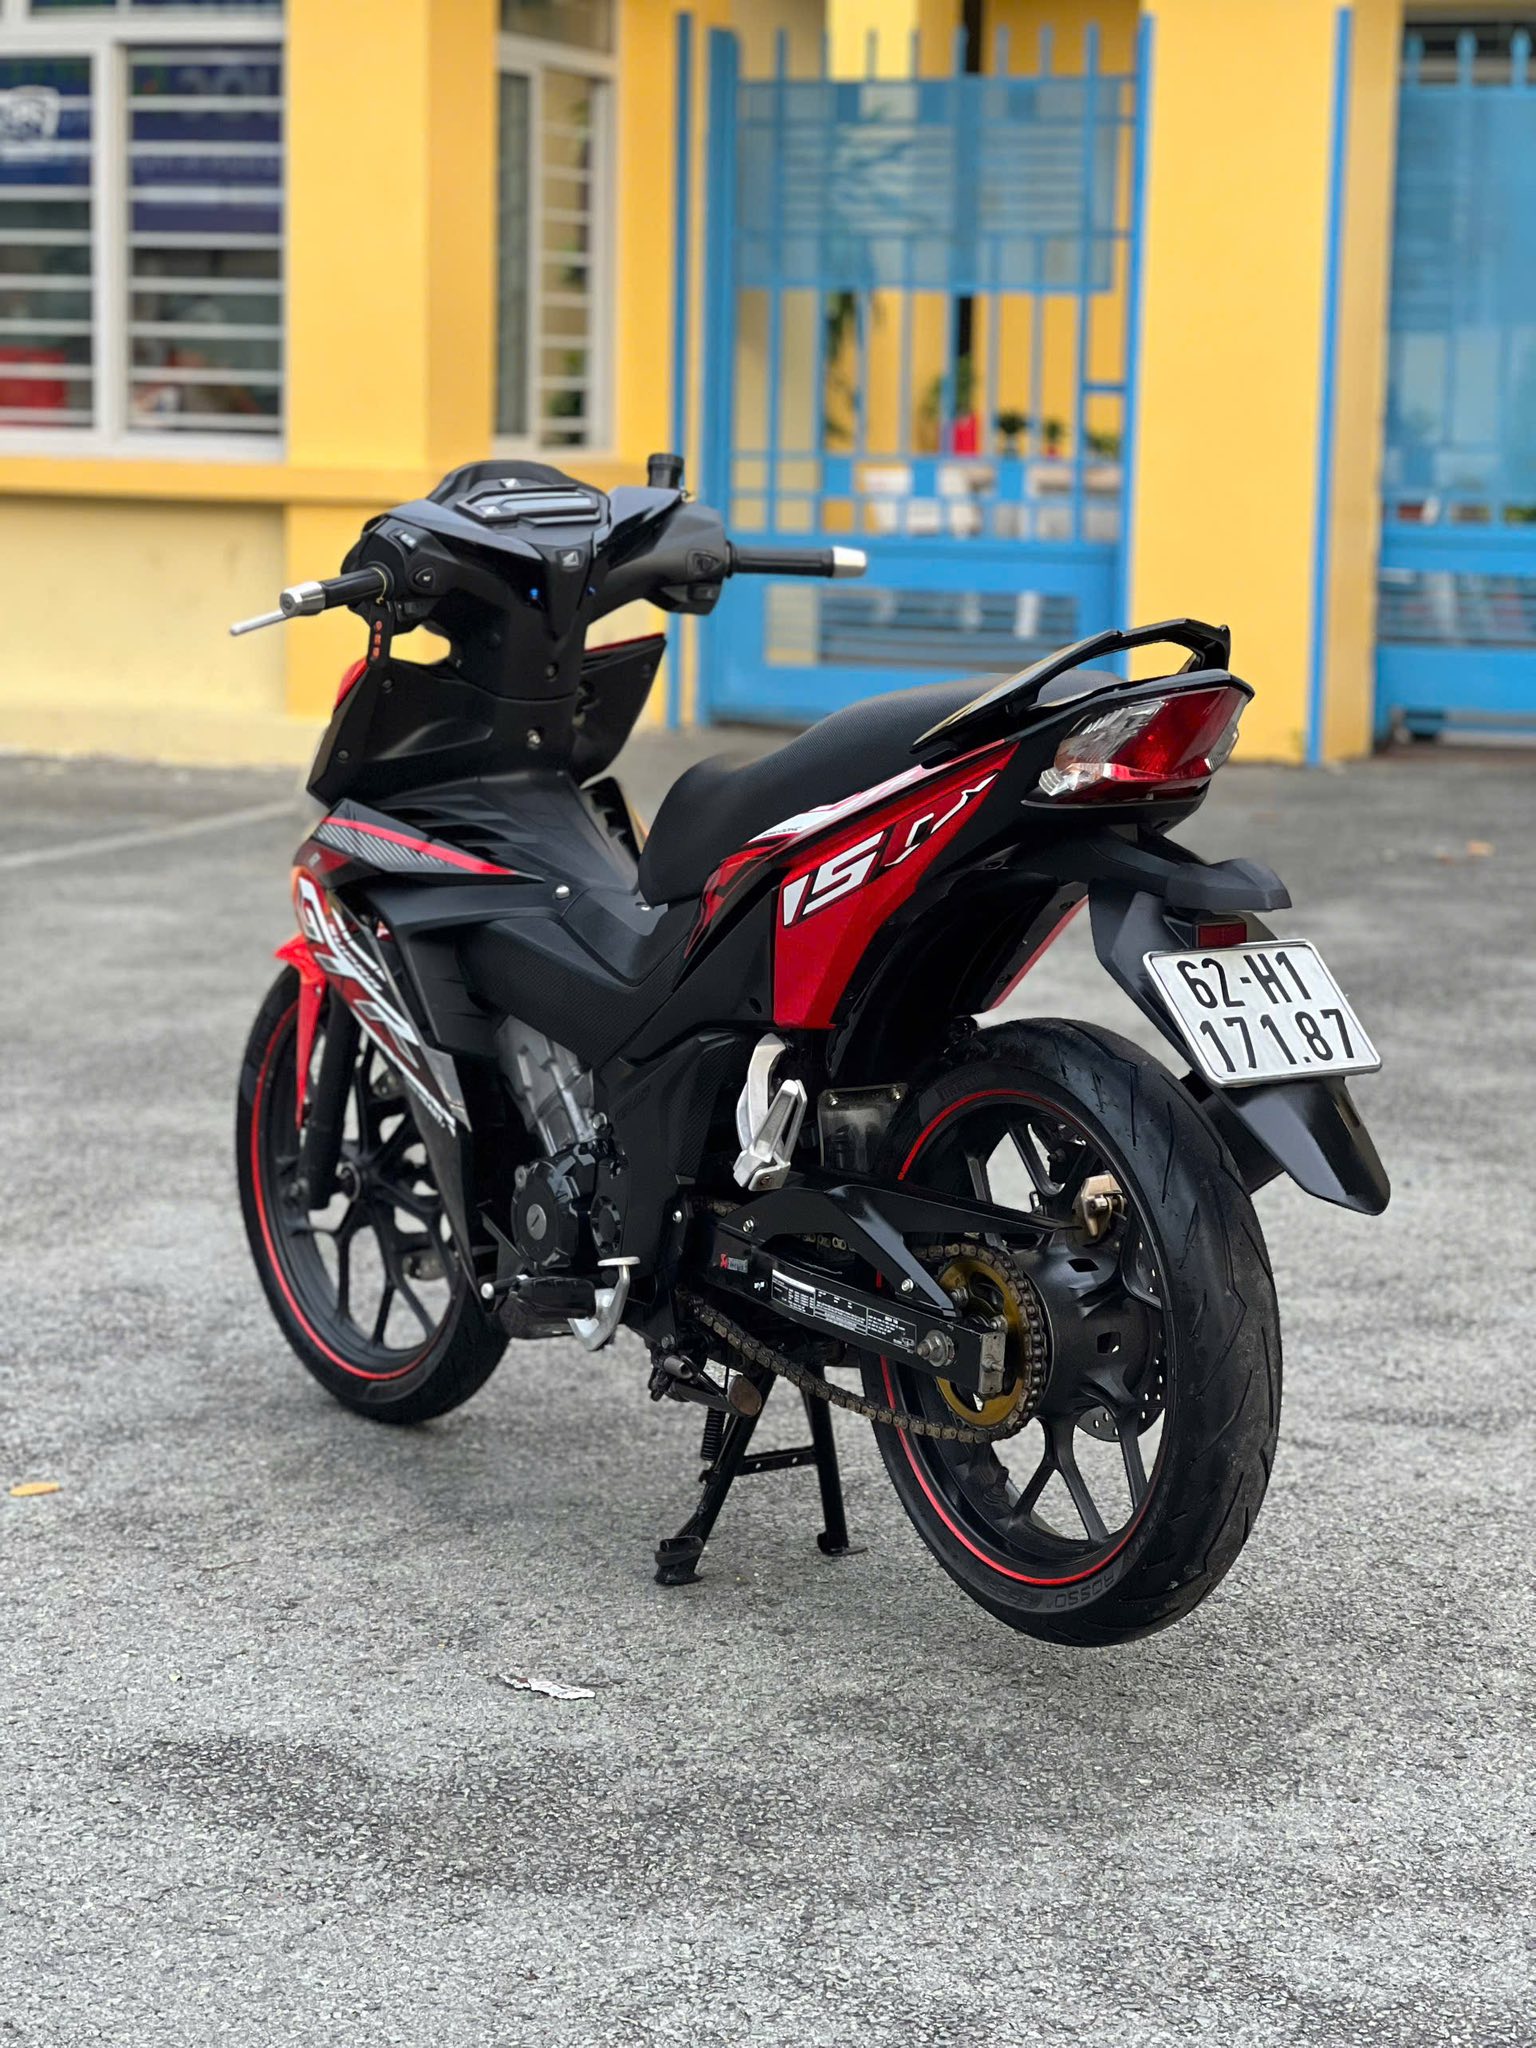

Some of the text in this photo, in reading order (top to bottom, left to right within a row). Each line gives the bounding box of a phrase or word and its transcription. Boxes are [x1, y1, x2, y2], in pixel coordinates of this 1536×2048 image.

[1177, 951, 1312, 1009] 62-H1
[1199, 1008, 1354, 1074] 171.87
[1054, 1571, 1115, 1609] ROSSO
